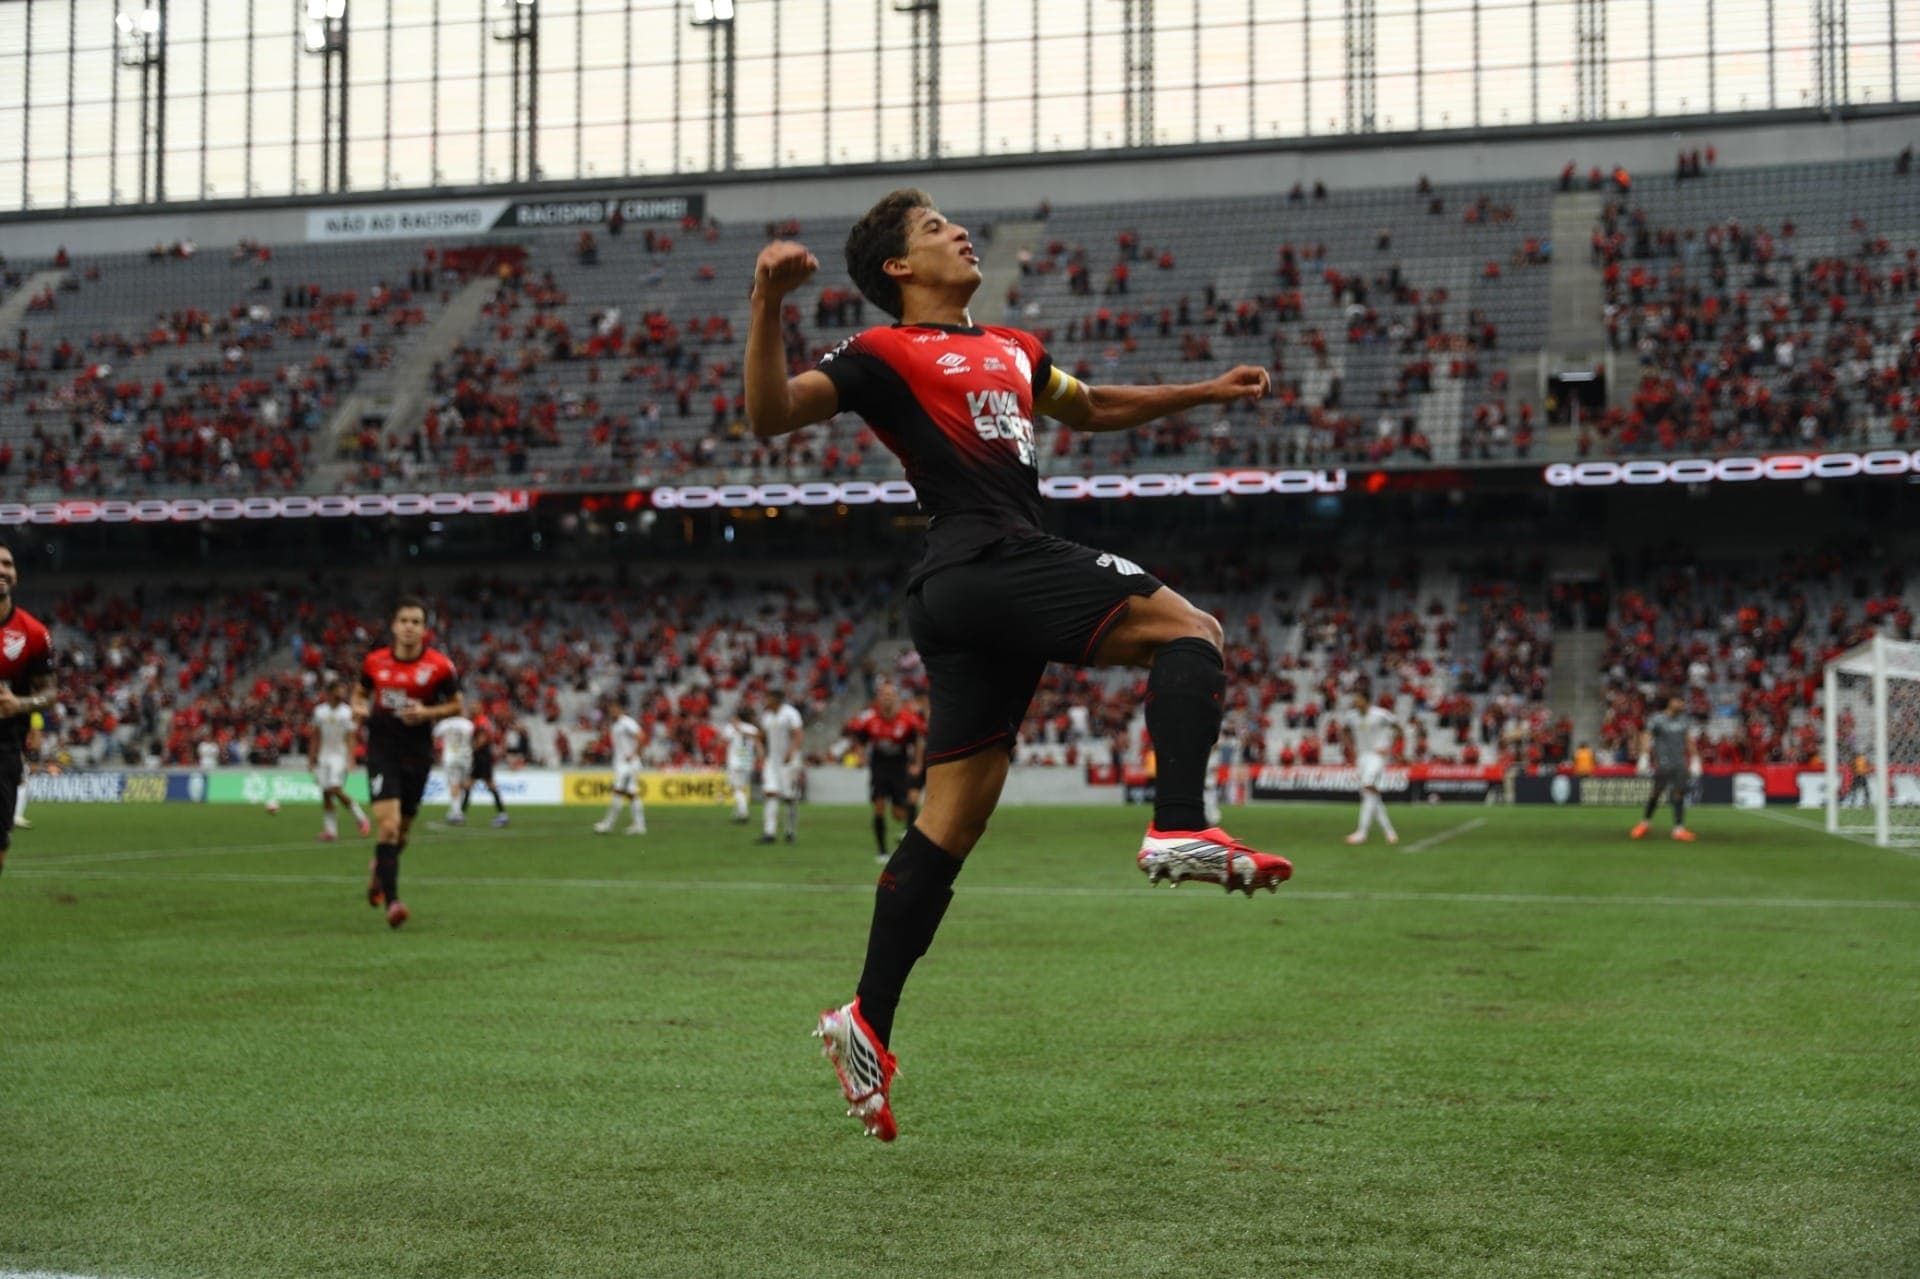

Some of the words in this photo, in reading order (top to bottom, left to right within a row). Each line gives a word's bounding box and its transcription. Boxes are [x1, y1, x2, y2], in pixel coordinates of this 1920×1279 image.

[325, 206, 366, 233] NÃO
[369, 211, 396, 232] AO
[401, 207, 482, 230] RACISMO
[517, 202, 603, 225] RACISMO
[966, 390, 1020, 417] VIVA
[974, 415, 1035, 443] SORT
